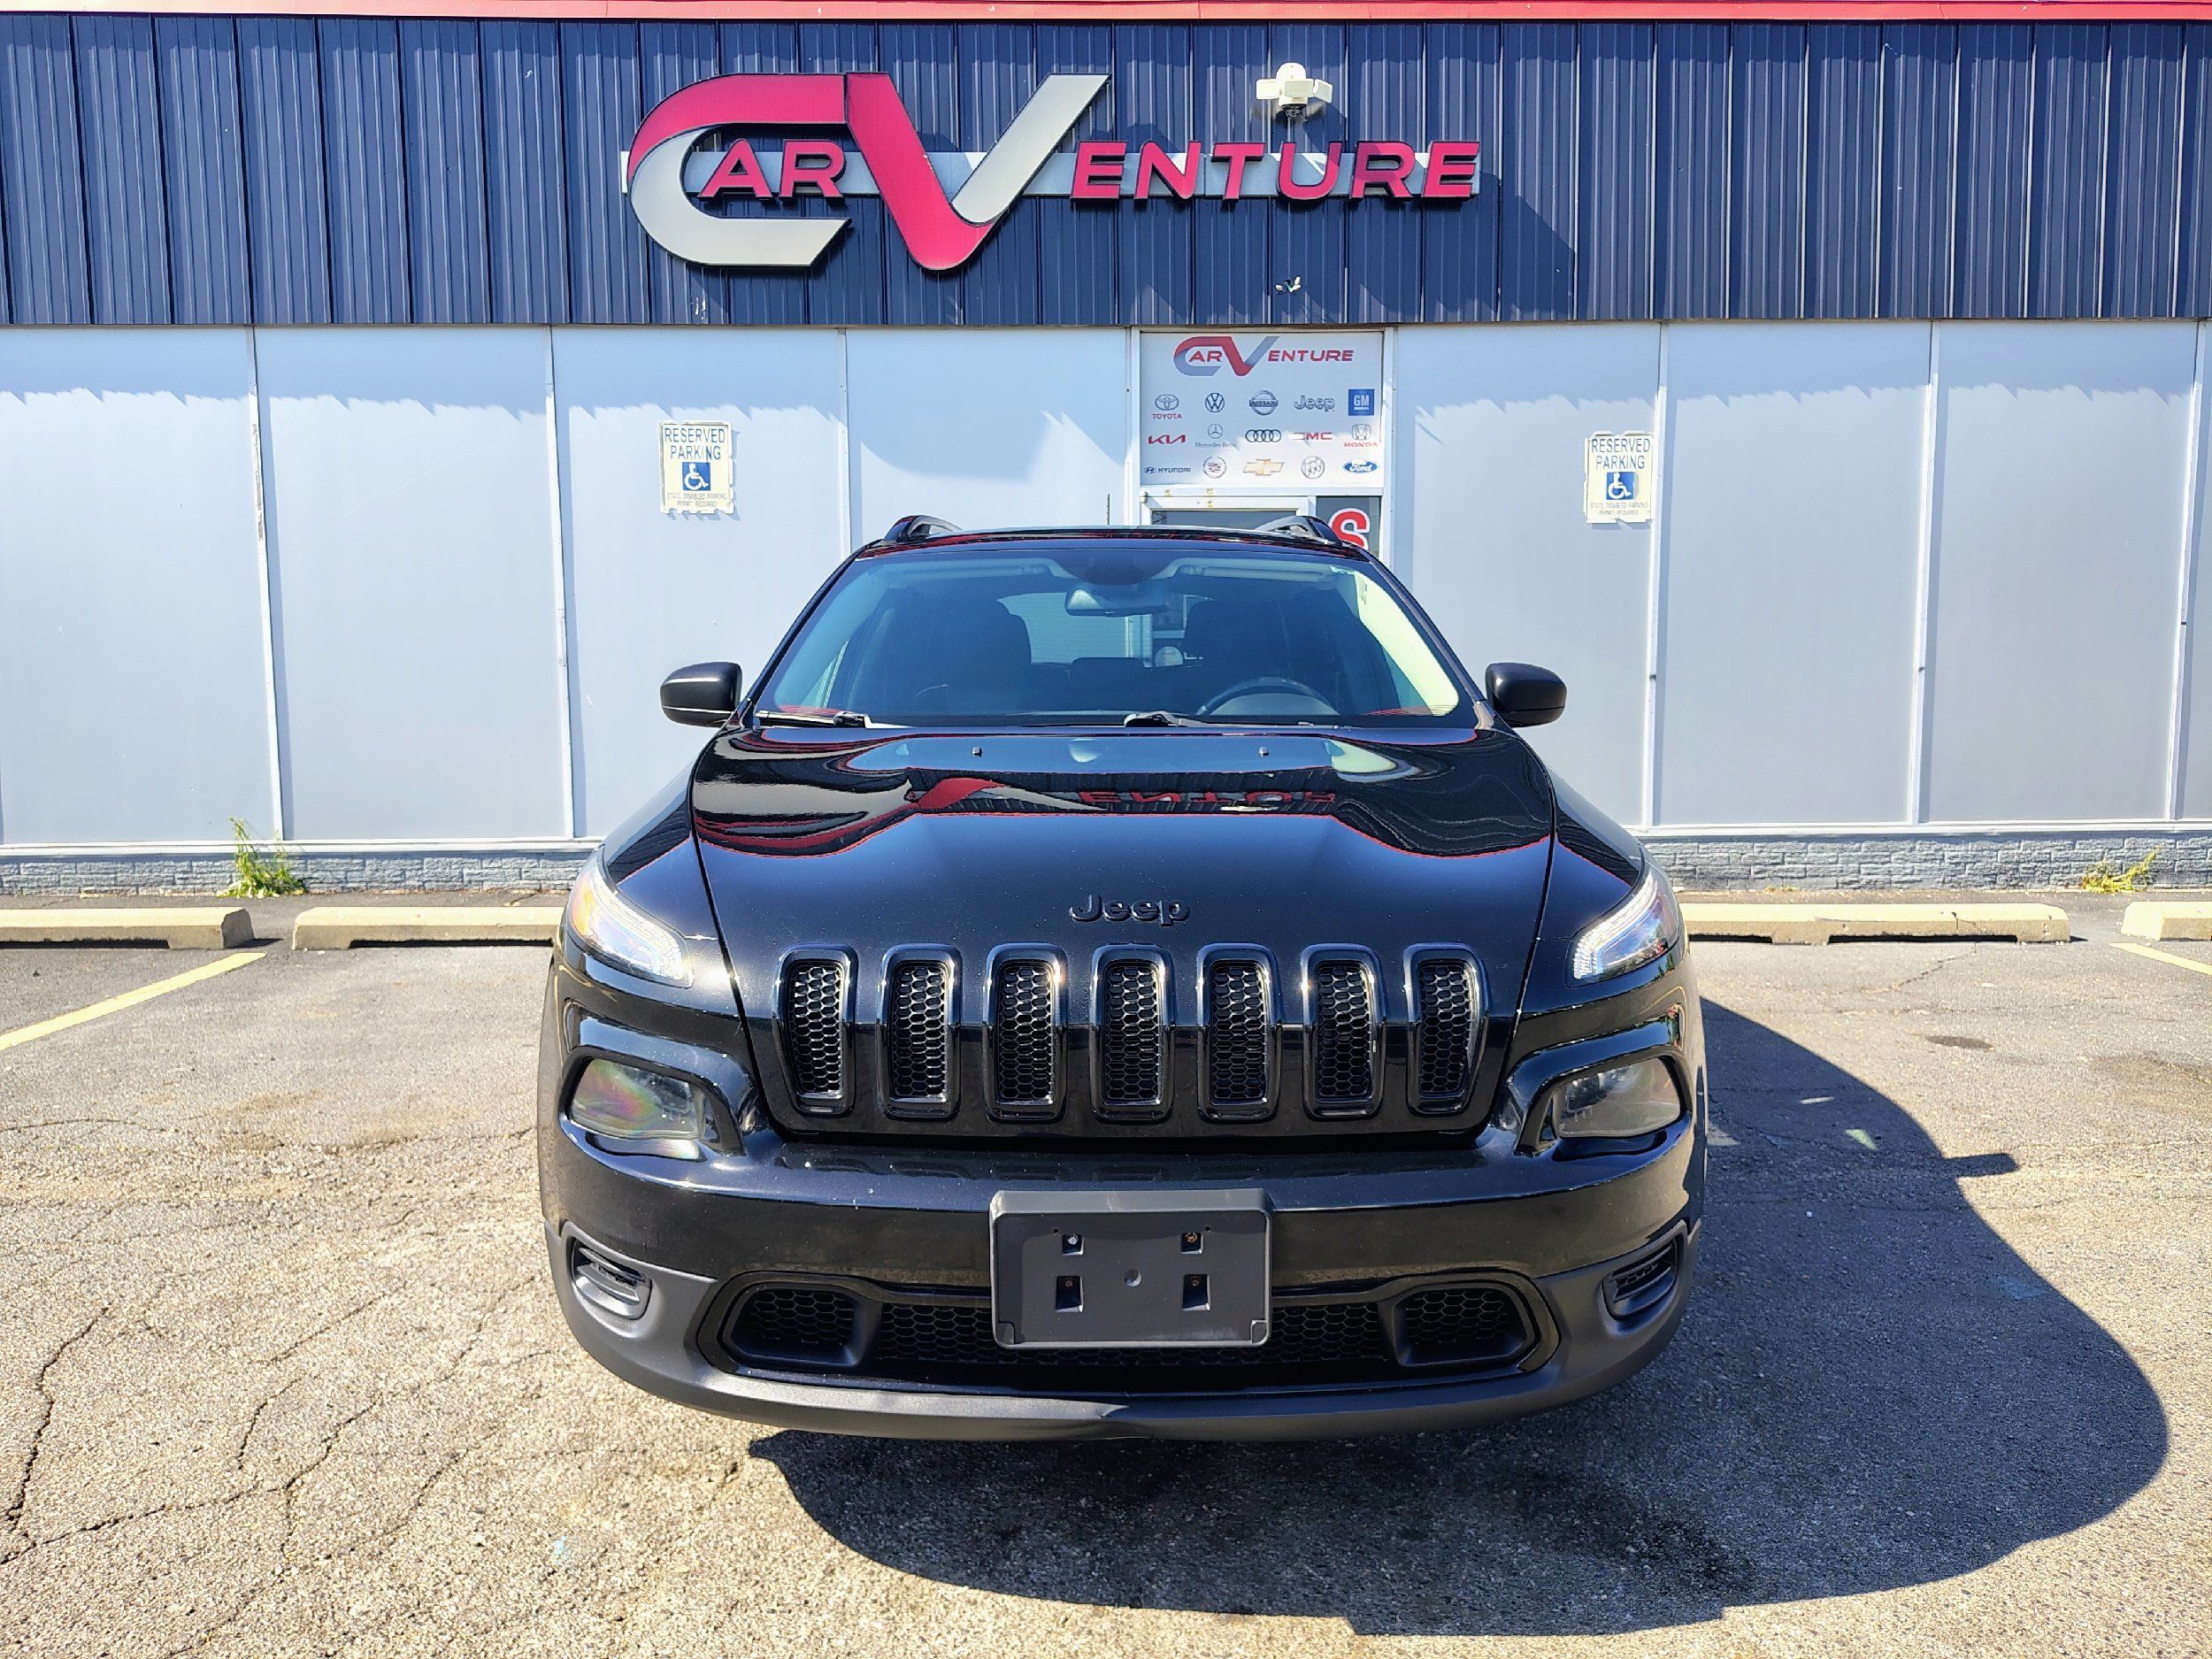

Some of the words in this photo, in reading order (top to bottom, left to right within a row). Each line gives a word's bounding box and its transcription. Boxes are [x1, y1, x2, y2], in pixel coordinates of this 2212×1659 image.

[1294, 395, 1334, 412] Jeep
[664, 427, 726, 442] RESERVED
[1148, 434, 1187, 444] KIA
[670, 444, 721, 460] PARKING
[1591, 438, 1651, 453] RESERVED
[1595, 455, 1645, 470] PARKING
[1068, 894, 1191, 927] Jeep
